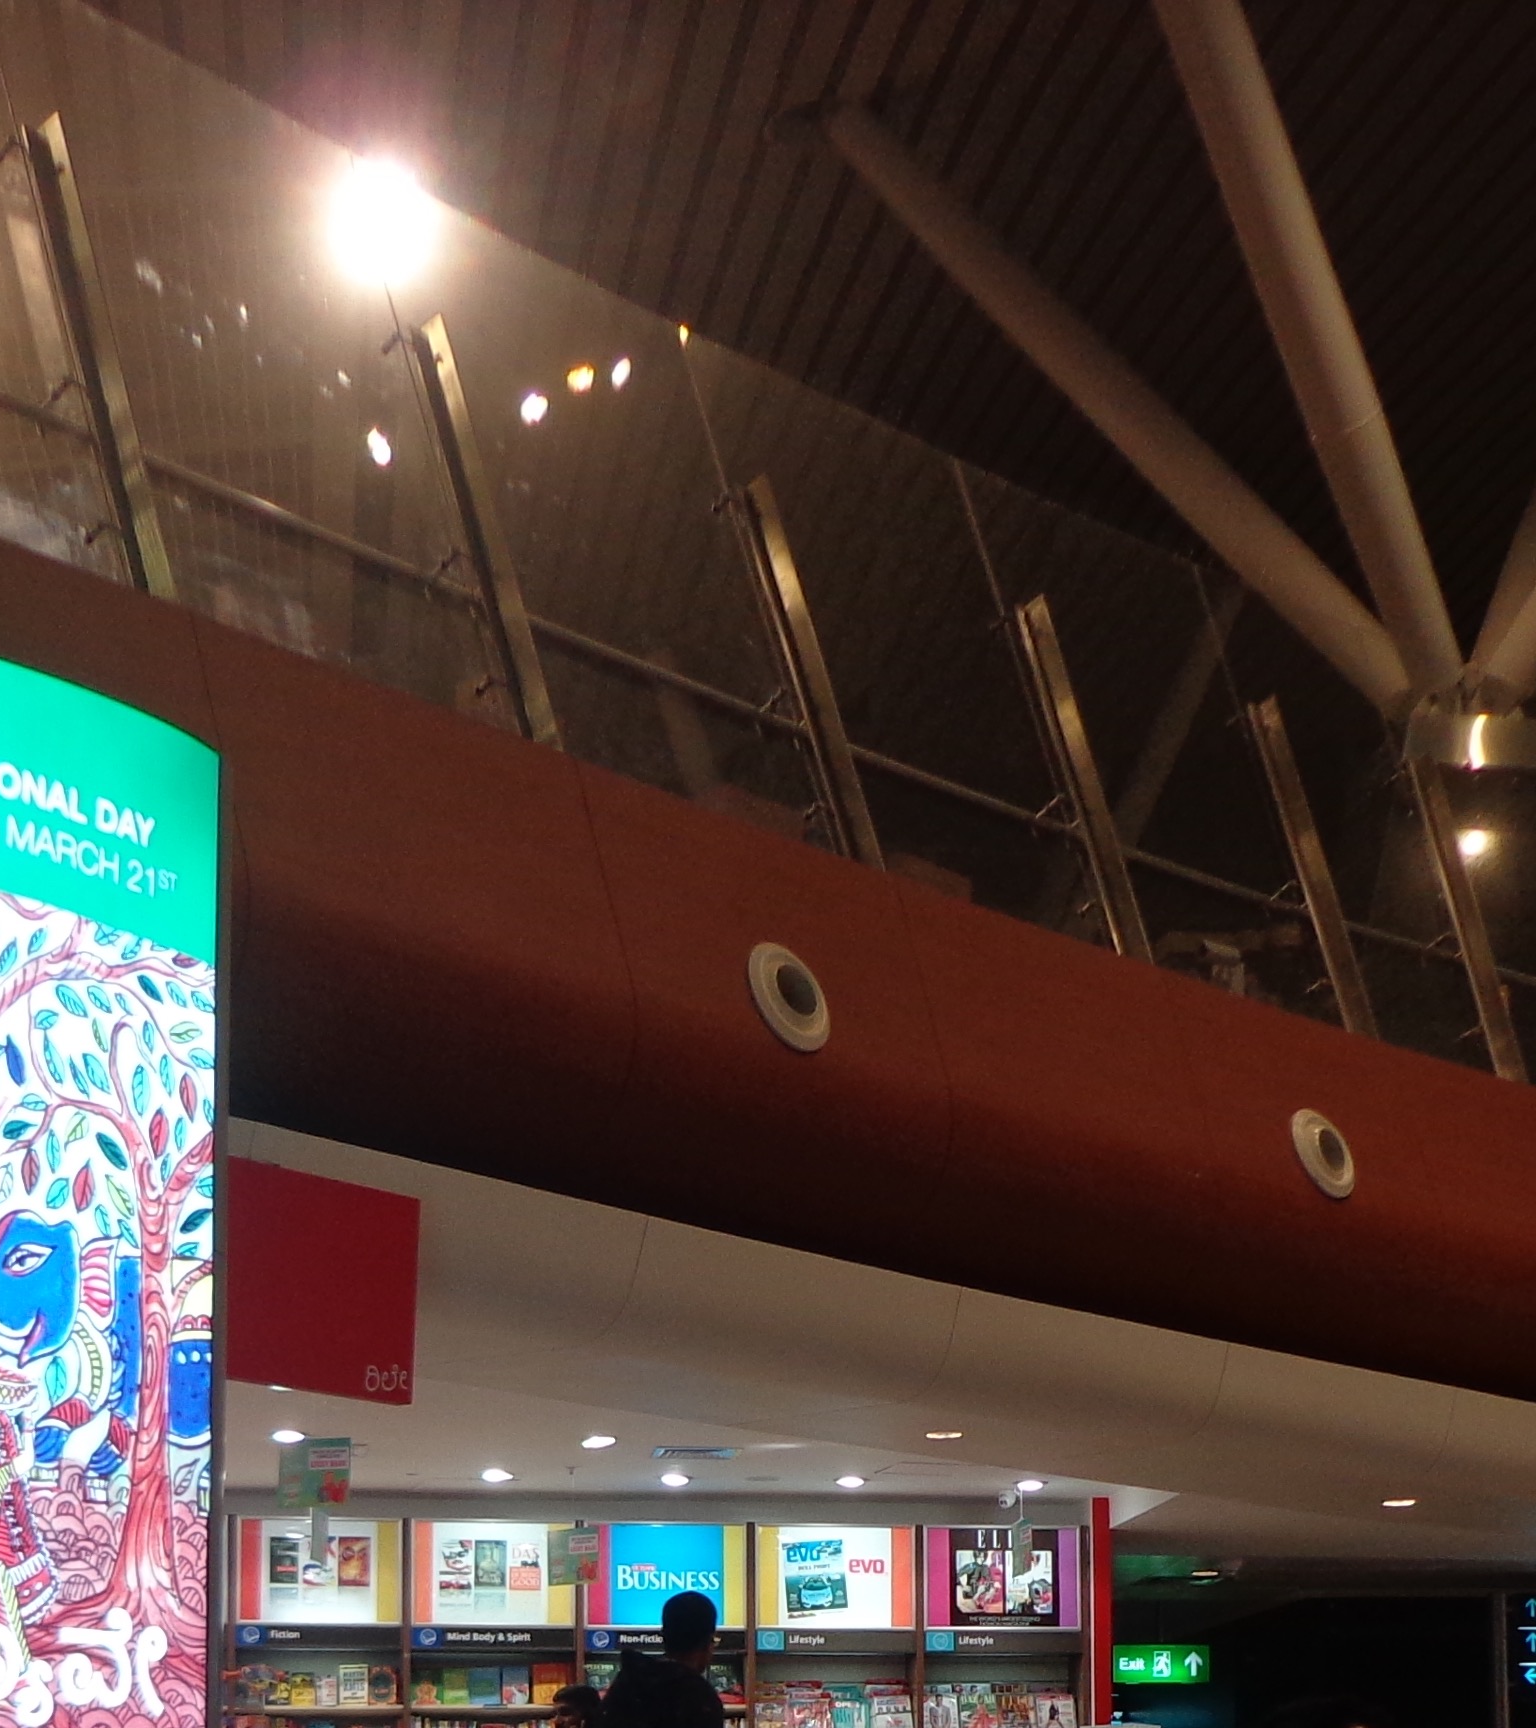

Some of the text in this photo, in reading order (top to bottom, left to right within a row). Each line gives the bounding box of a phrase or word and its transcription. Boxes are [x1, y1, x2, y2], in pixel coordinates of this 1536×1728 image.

[94, 796, 156, 848] DAY
[5, 813, 121, 886] MARCH
[848, 1558, 885, 1574] evo
[270, 1629, 301, 1640] Fiction
[446, 1632, 532, 1643] Mind Body & Spirit
[619, 1634, 663, 1644] Non-Fictio
[788, 1635, 825, 1646] Lifestyle
[958, 1636, 994, 1646] Lifestyle
[1119, 1657, 1145, 1671] Exit
